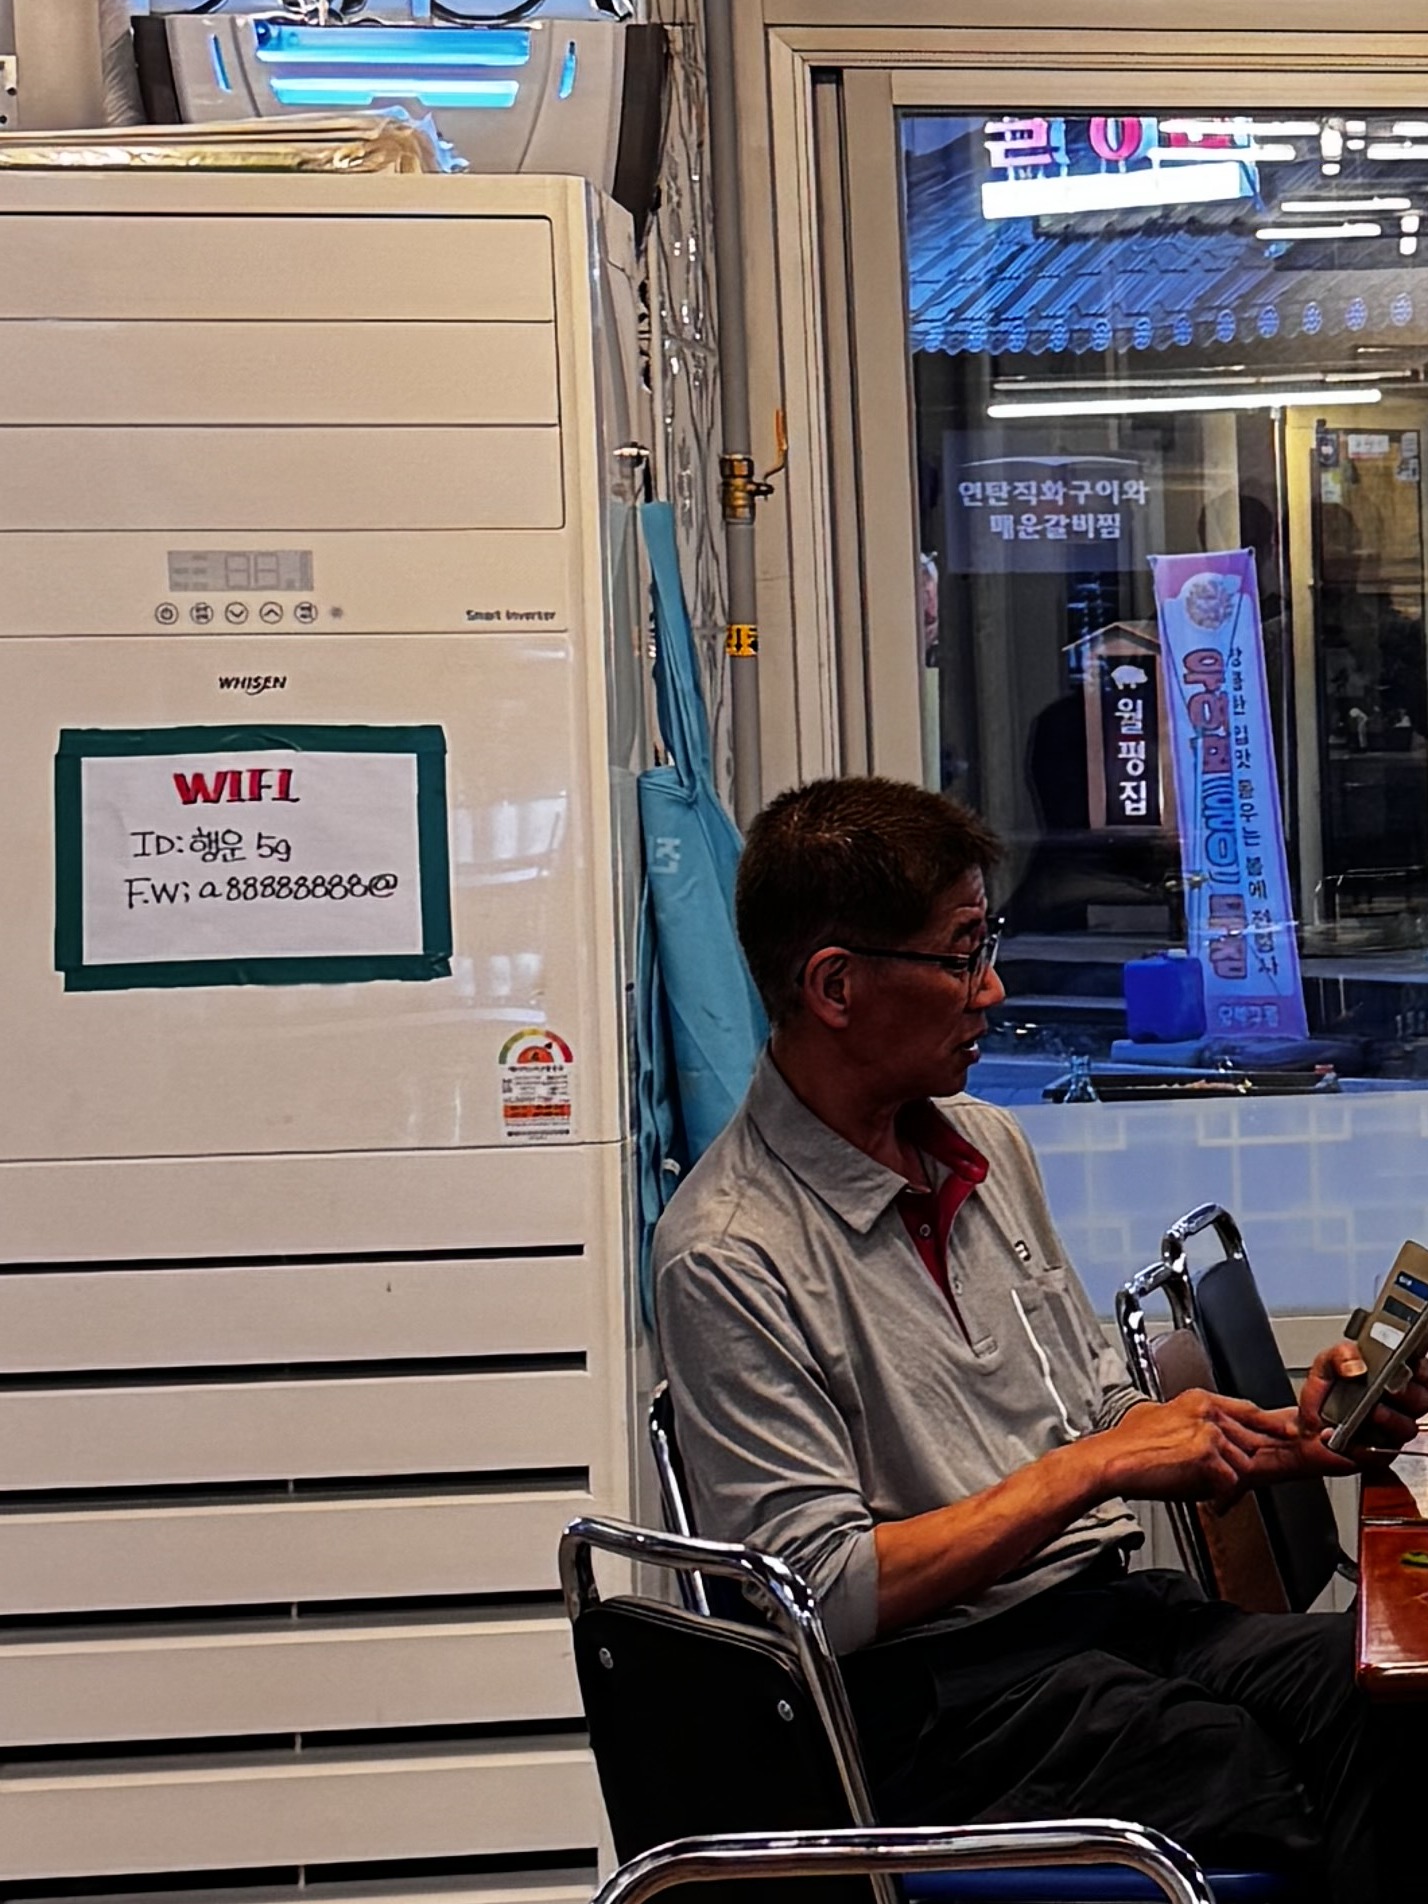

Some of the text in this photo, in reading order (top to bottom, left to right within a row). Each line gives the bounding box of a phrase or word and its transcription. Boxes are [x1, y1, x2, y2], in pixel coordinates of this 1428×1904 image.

[958, 479, 1149, 507] 연탄직화구이와
[990, 512, 1121, 539] 매운갈비찜
[218, 676, 287, 696] WHISEN
[1114, 698, 1147, 816] 월평집
[172, 769, 300, 805] WIFI
